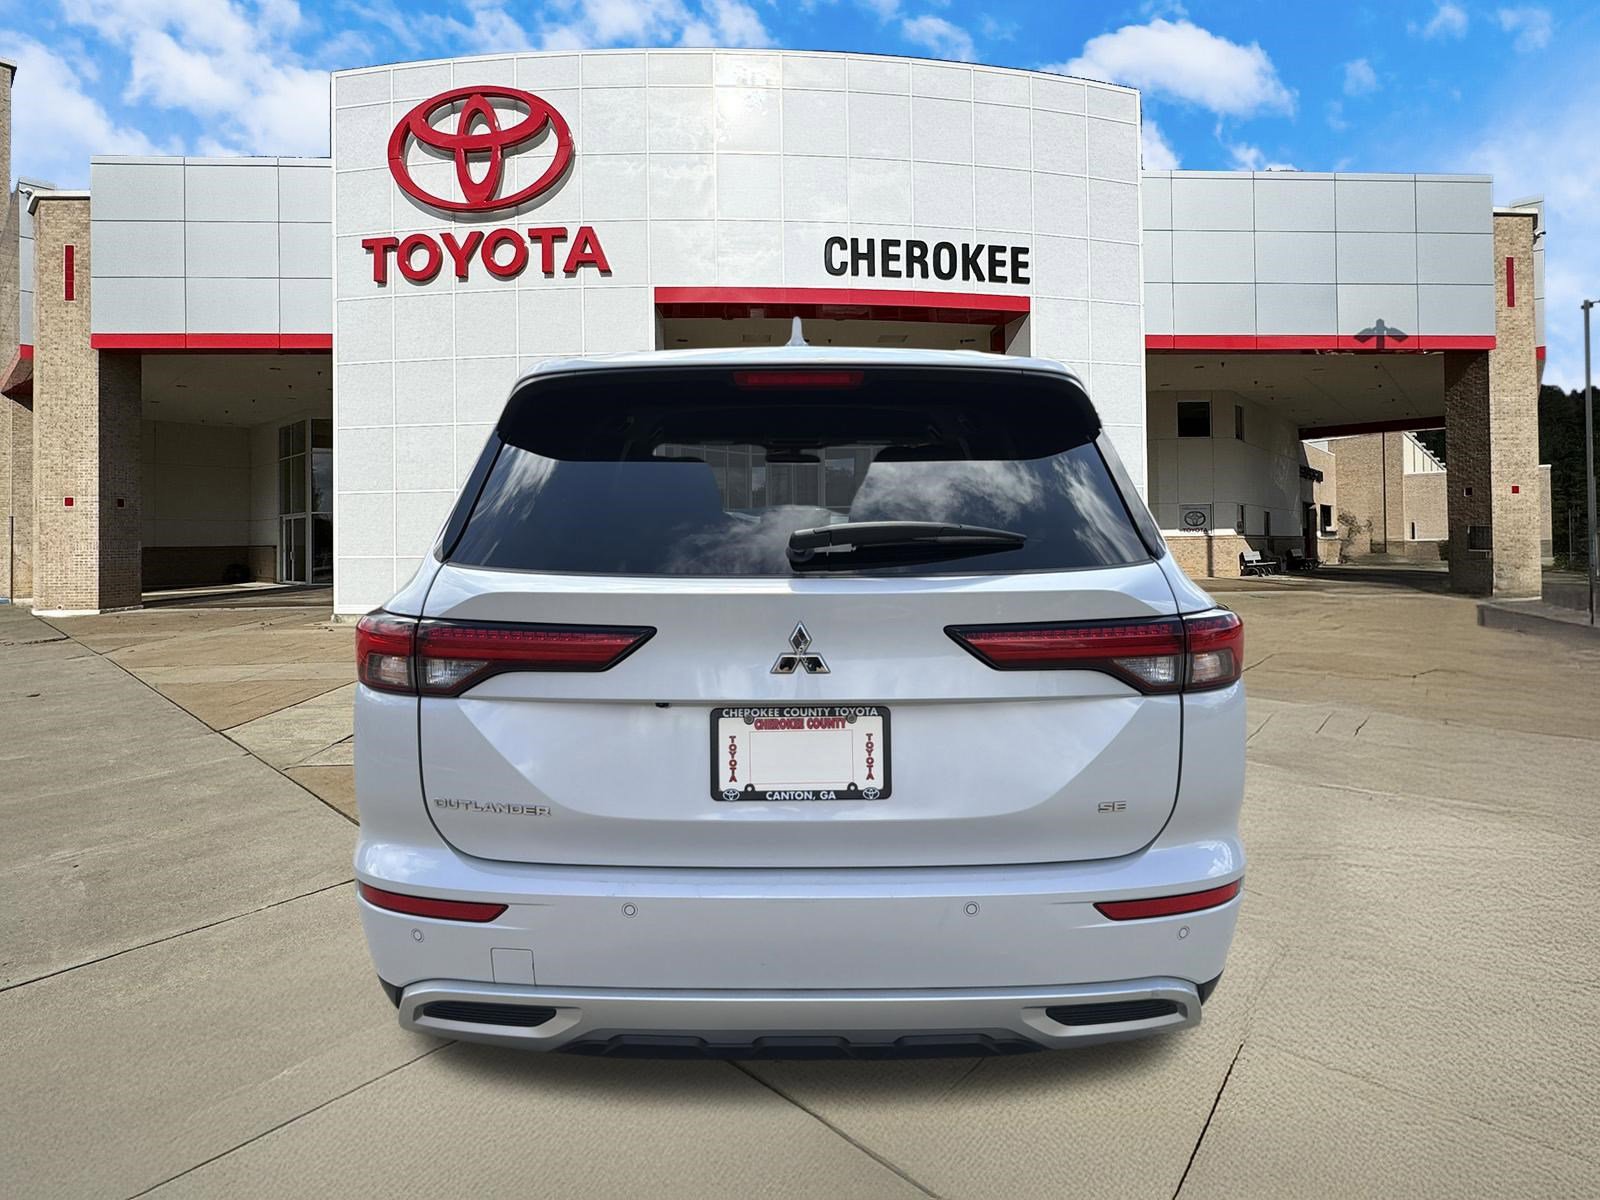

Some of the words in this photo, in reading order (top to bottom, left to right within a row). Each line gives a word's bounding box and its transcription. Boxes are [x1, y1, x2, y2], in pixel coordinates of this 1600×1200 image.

[362, 226, 612, 284] TOYOTA
[824, 236, 1031, 285] CHEROKEE
[722, 708, 780, 718] CHEROKEE
[783, 707, 831, 717] COUNTY
[835, 706, 878, 716] TOYOTA
[754, 718, 805, 730] CHEROKEE
[806, 717, 846, 729] COUNTY
[728, 735, 738, 783] TOYOTA
[865, 733, 875, 780] TOYOTA
[765, 790, 816, 801] CANTON,
[819, 790, 837, 800] GA
[433, 798, 552, 816] OUTLANDER
[1097, 800, 1127, 814] SE
